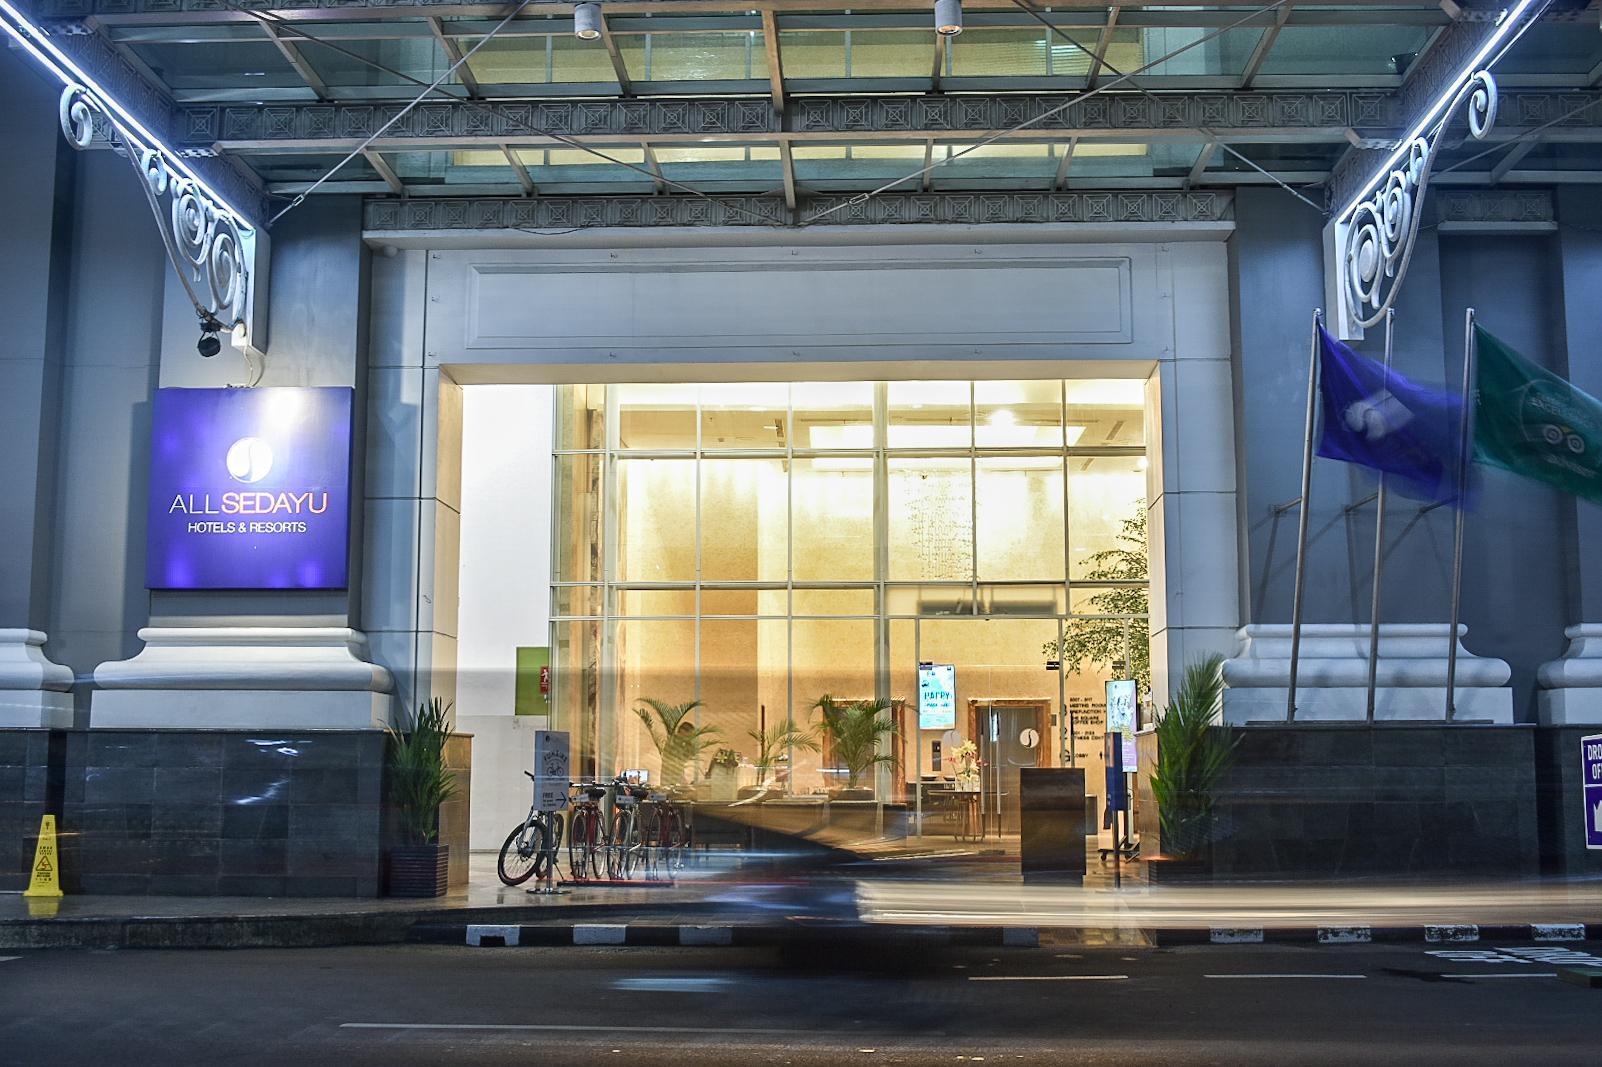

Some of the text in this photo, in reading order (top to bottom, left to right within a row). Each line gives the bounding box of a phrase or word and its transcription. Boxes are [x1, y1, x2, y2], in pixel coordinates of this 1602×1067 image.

[188, 521, 307, 534] HOTELS & RESORTS
[1587, 743, 1602, 761] DRO
[1592, 762, 1602, 780] OF
